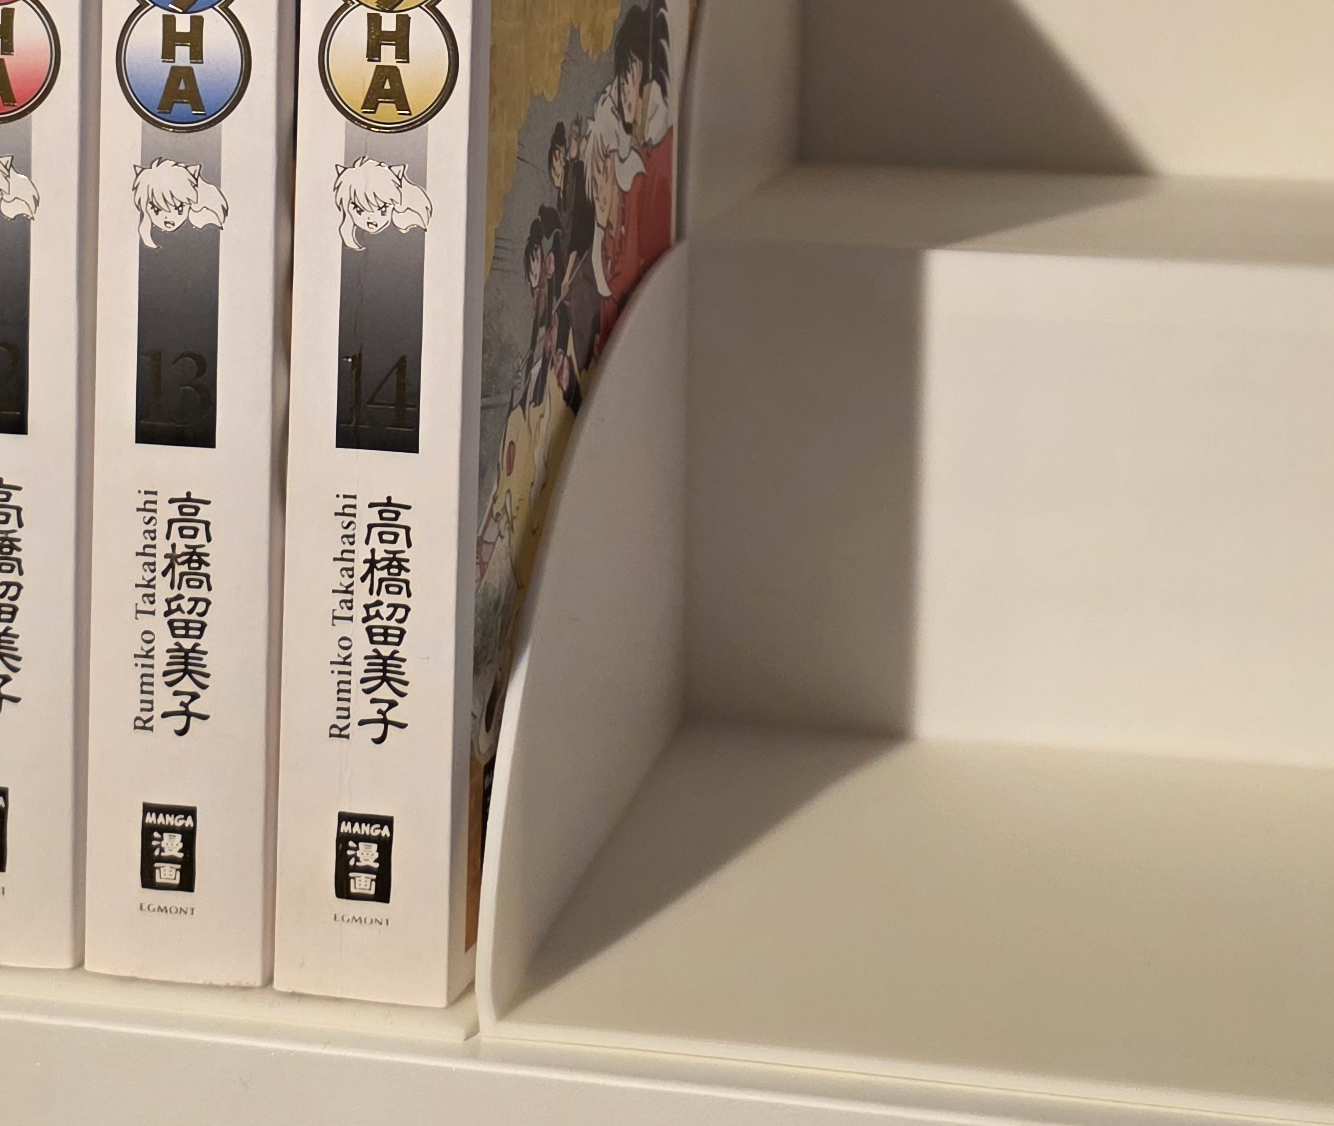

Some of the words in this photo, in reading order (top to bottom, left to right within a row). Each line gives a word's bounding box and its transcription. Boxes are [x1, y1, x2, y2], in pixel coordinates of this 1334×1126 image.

[139, 350, 212, 426] 13
[340, 354, 416, 431] 14
[135, 490, 157, 620] Takahashi
[332, 494, 357, 626] Takahashi
[161, 491, 212, 736] 高橋留美子
[358, 496, 412, 744] 高橋留美子
[134, 630, 155, 732] Rumiko
[329, 636, 352, 739] Rumiko
[145, 812, 193, 827] MANGA
[340, 821, 390, 837] MANGA
[140, 903, 194, 915] EGMONT
[334, 913, 389, 926] EGMONT
